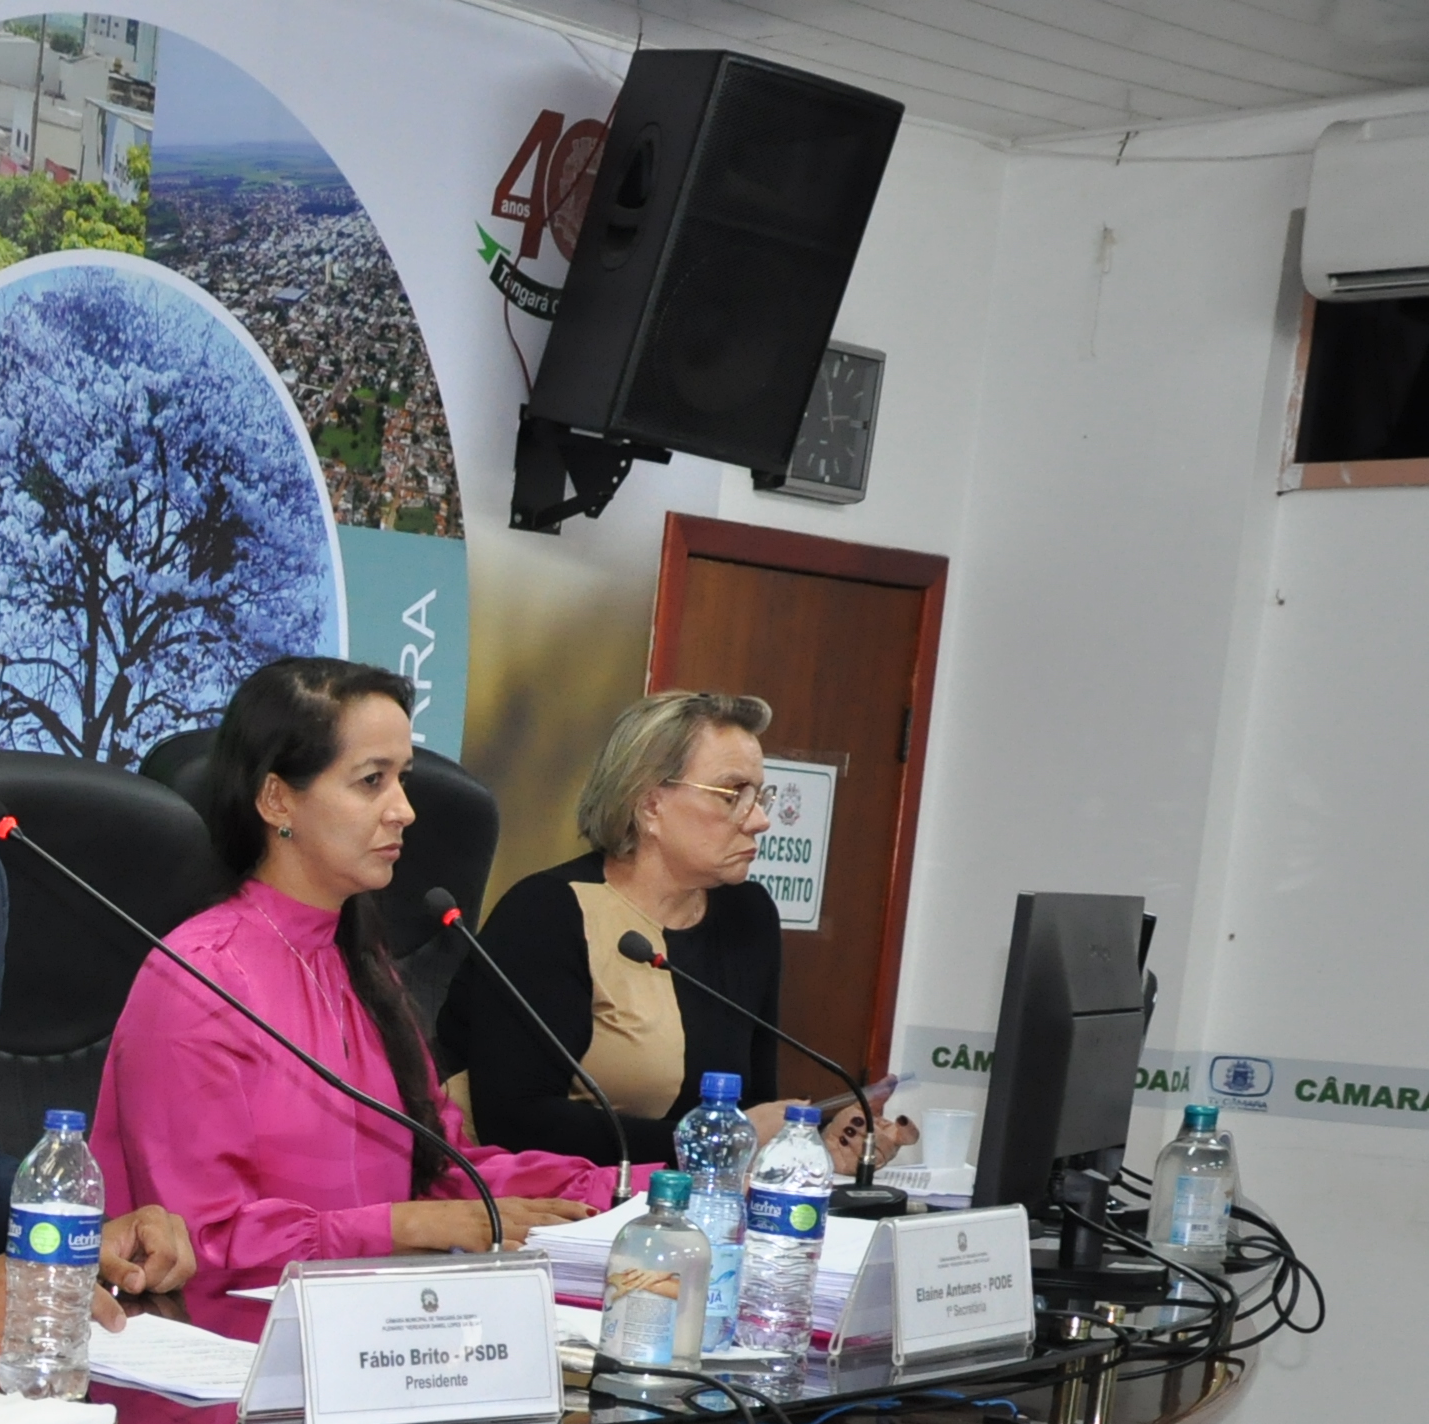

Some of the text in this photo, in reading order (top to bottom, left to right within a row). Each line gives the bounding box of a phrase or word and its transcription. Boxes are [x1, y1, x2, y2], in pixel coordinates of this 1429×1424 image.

[501, 199, 531, 218] anos
[757, 834, 812, 864] ACESSO
[748, 873, 814, 904] STRITO
[916, 1286, 944, 1303] Elaine
[946, 1282, 982, 1298] Antunes
[988, 1274, 1013, 1292] PODE
[359, 1350, 405, 1369] Fábio
[410, 1346, 450, 1367] Brito
[464, 1343, 509, 1362] PSDB
[405, 1374, 469, 1390] Presidente
